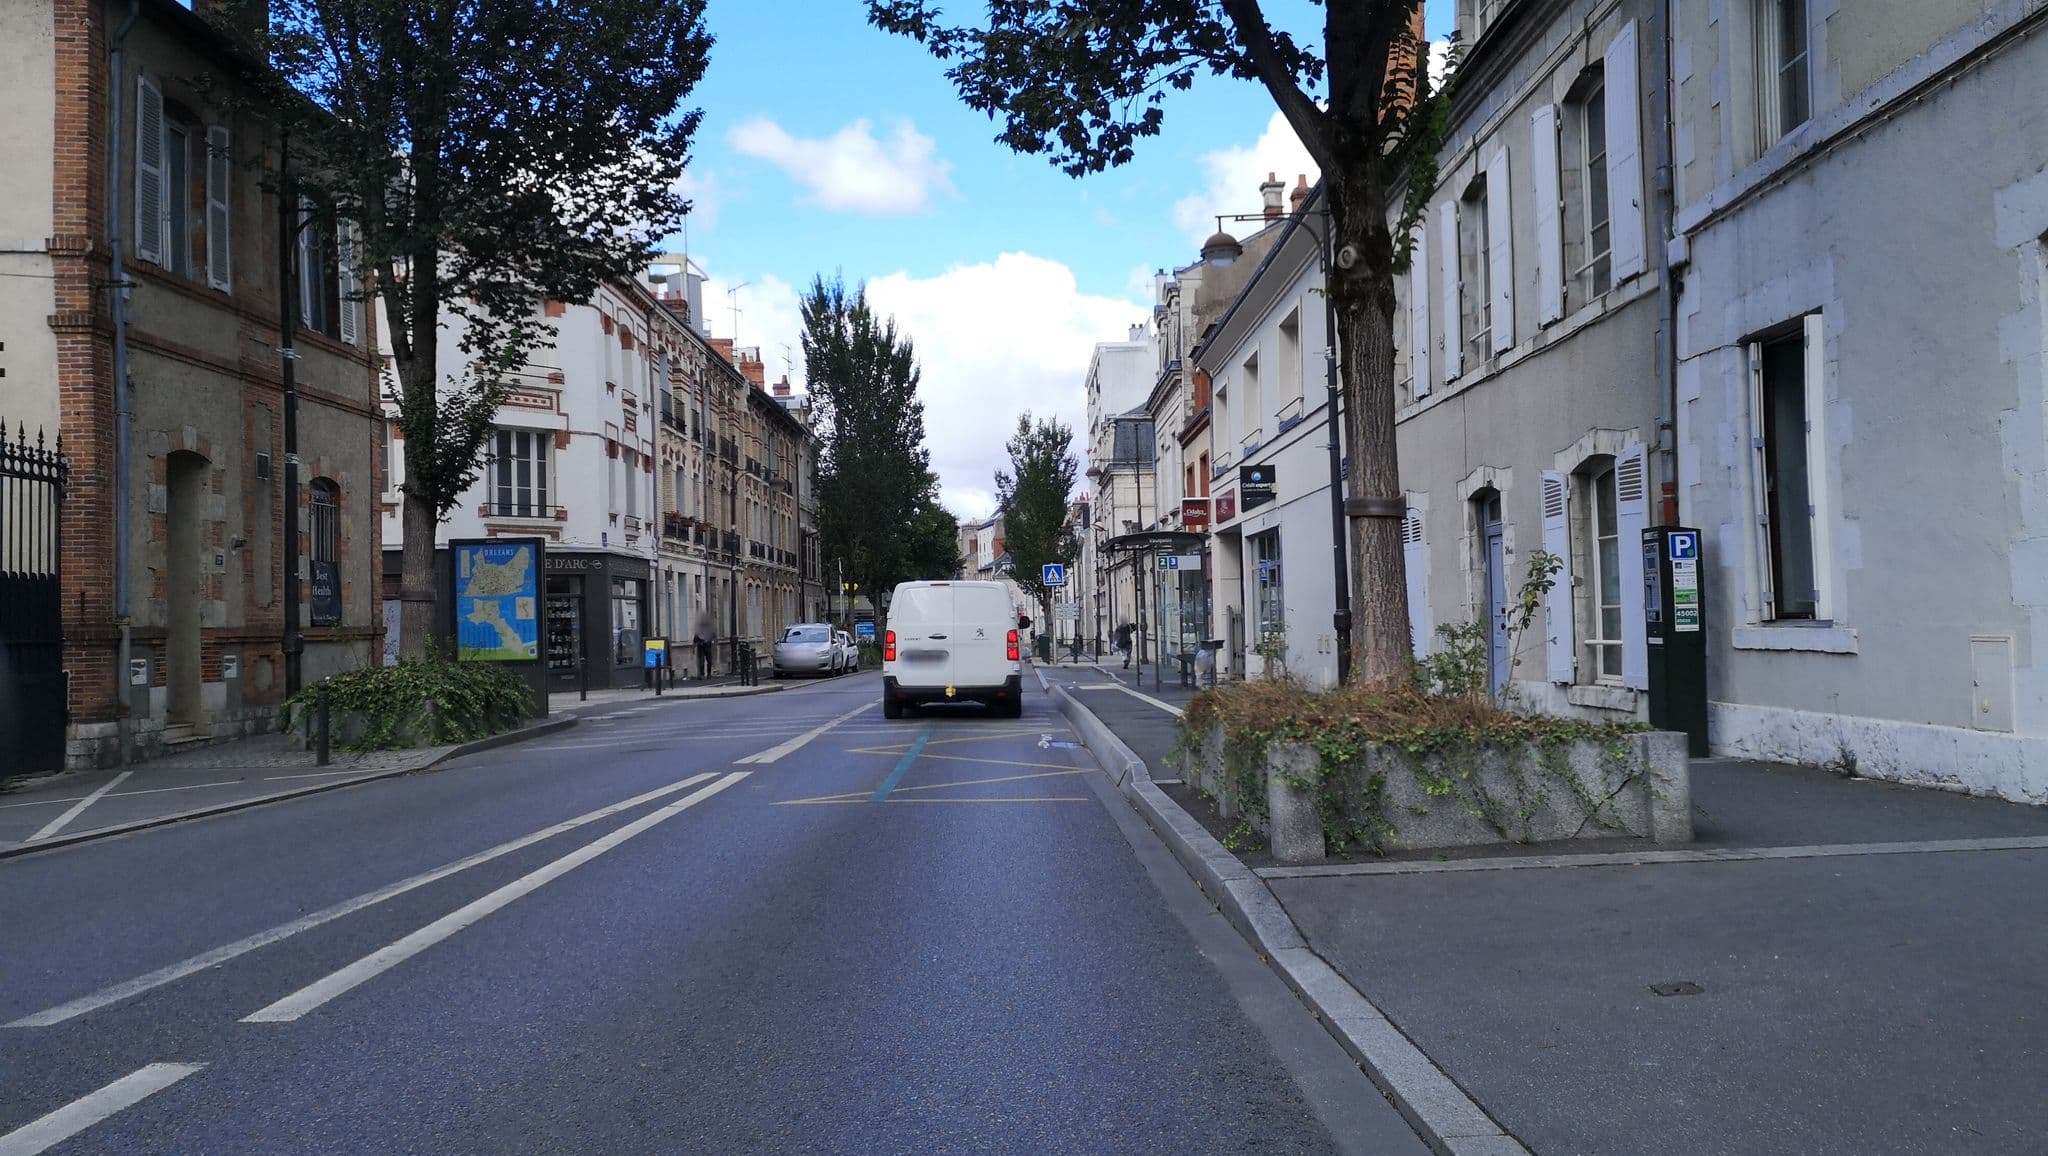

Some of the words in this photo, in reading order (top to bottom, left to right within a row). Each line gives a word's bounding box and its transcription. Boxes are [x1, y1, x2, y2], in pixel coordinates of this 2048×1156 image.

[1674, 535, 1691, 557] P
[555, 559, 588, 569] D'ARC
[1160, 558, 1166, 566] 2
